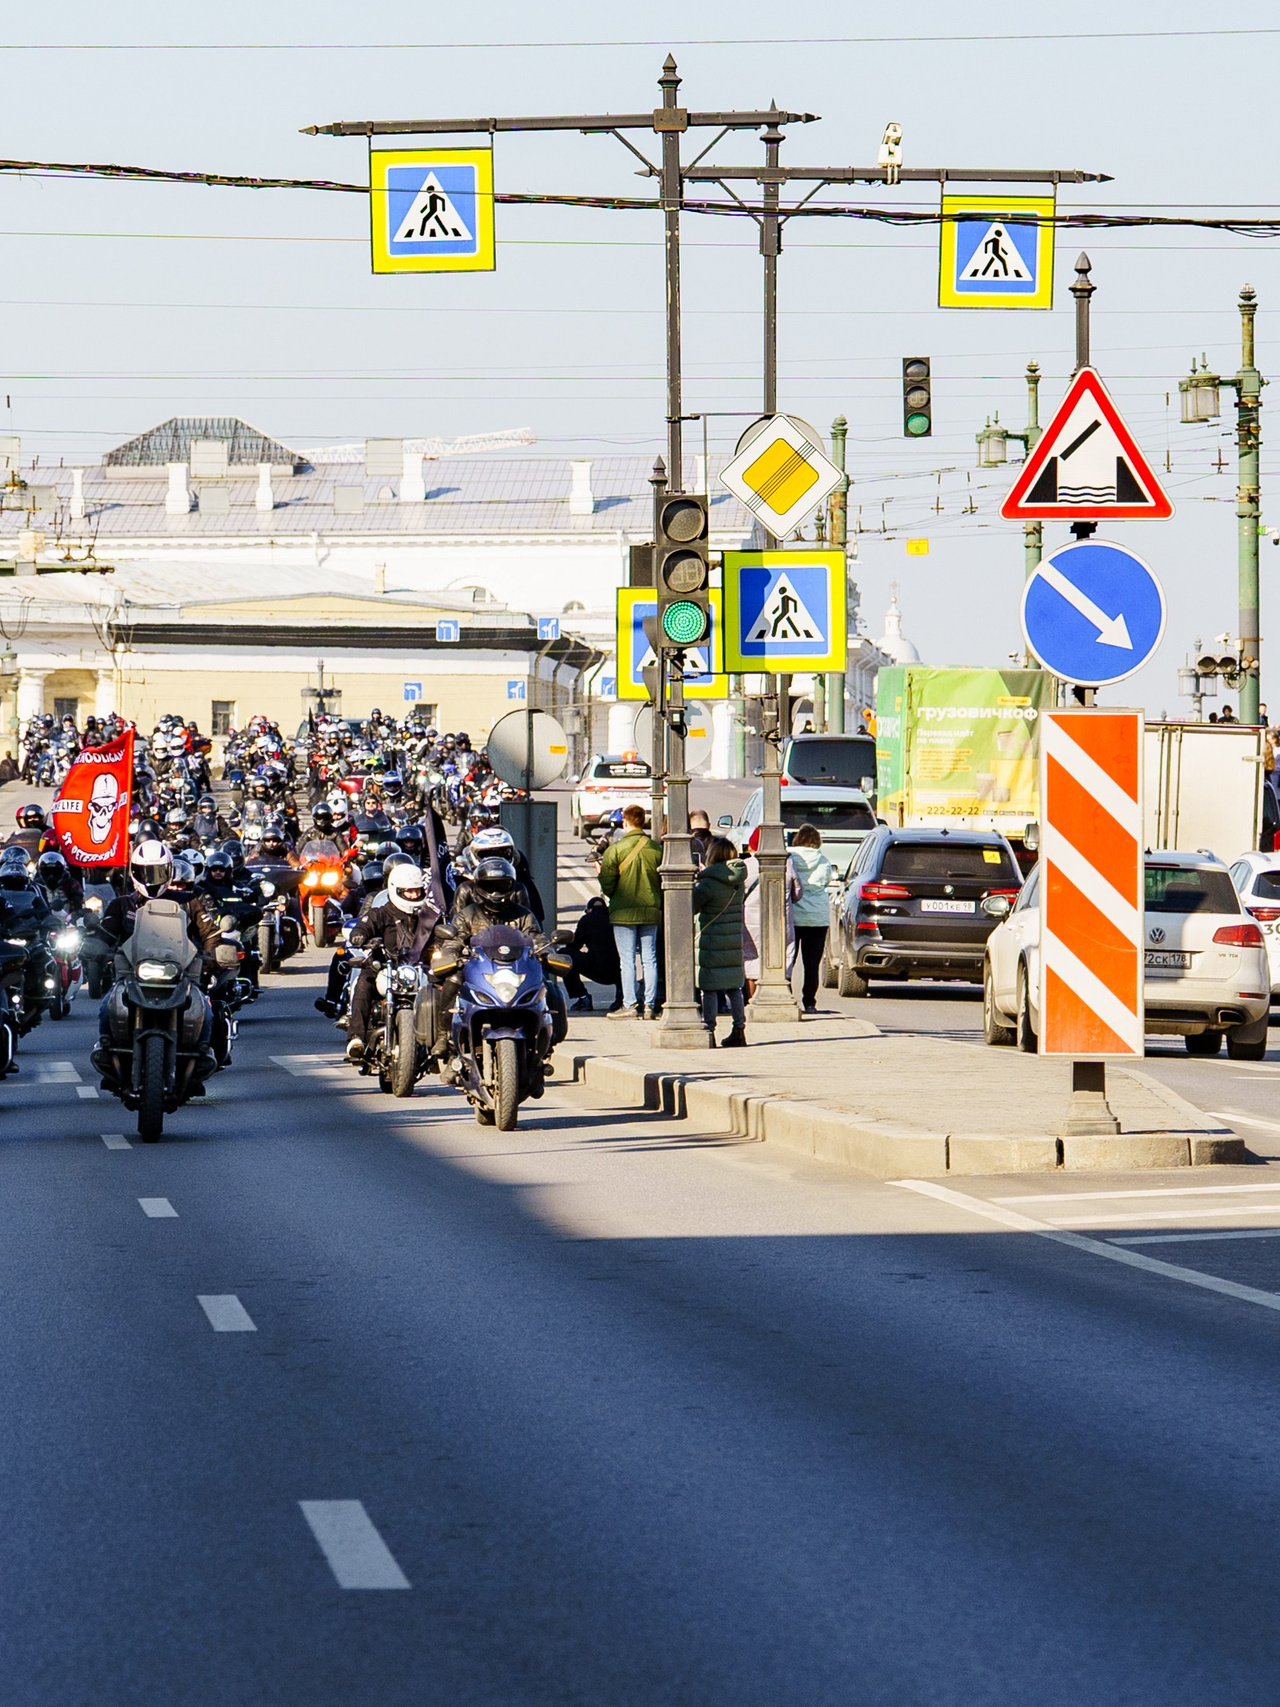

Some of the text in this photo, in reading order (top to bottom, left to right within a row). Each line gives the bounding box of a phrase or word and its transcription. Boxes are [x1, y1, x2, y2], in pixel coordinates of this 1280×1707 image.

[917, 706, 1038, 721] грузовичкоф
[61, 801, 79, 811] LIFE
[927, 806, 980, 816] 222-22-22
[71, 832, 120, 863] PETERSBU
[1171, 954, 1187, 963] 178
